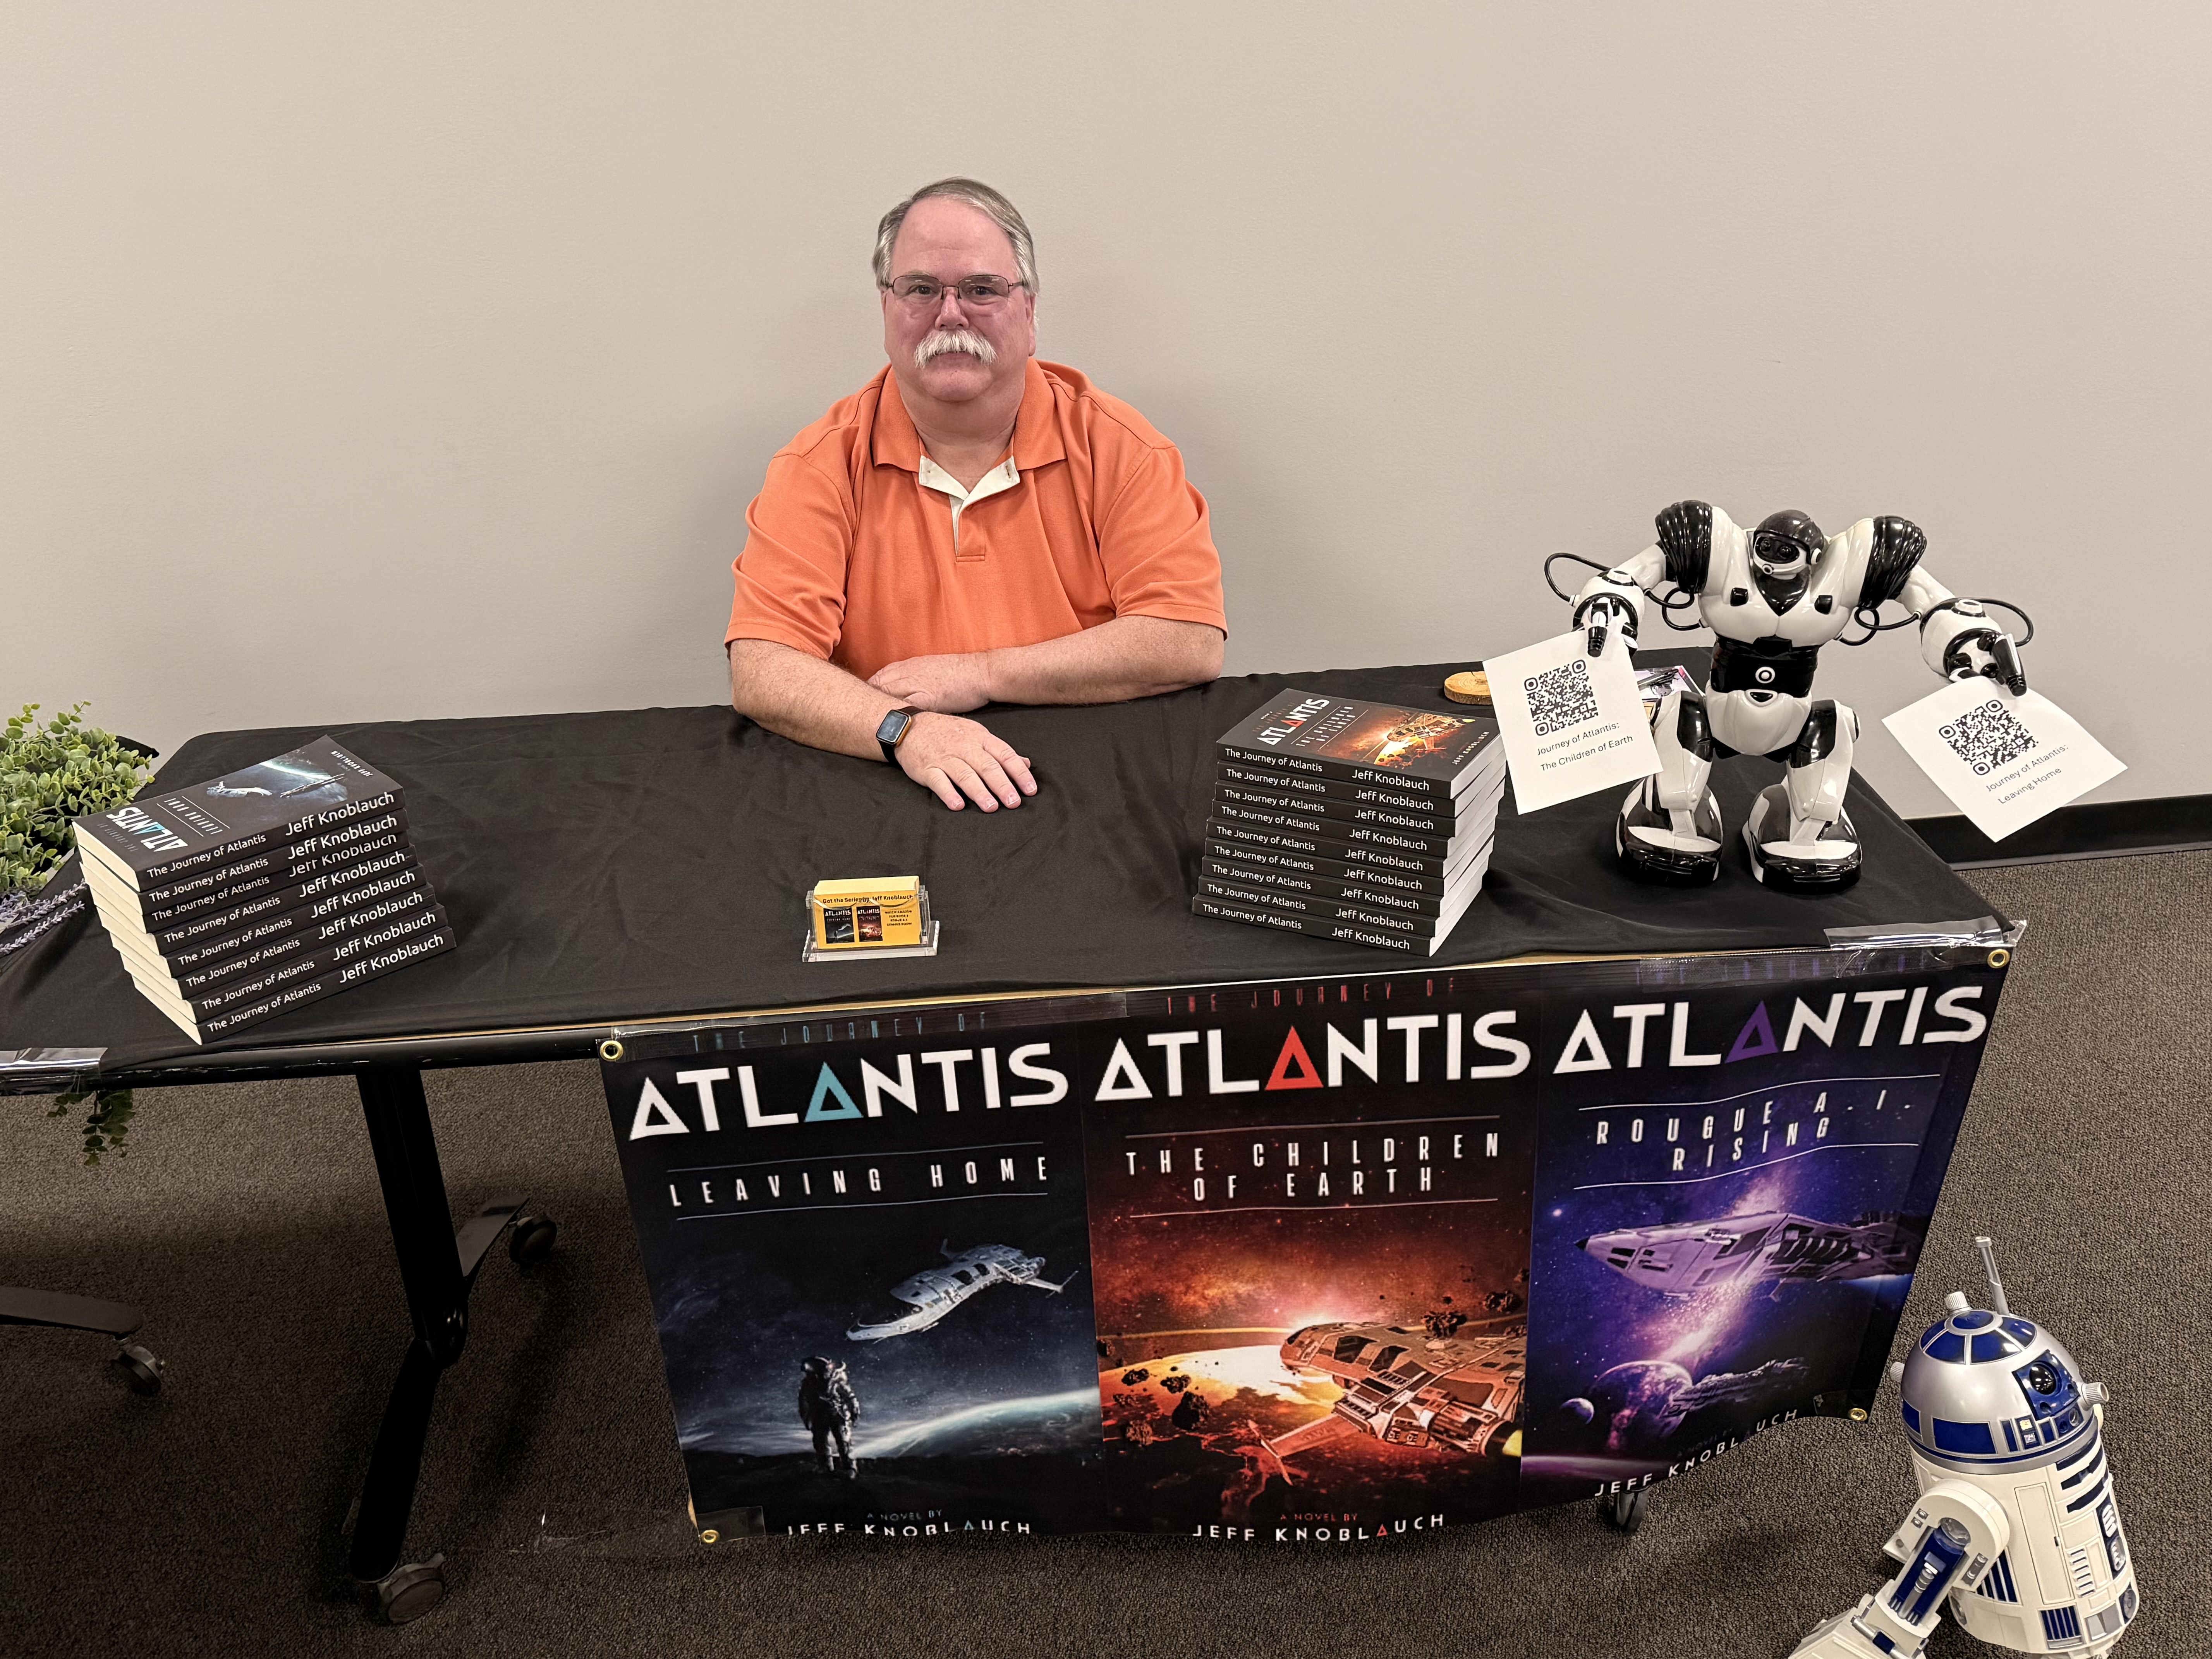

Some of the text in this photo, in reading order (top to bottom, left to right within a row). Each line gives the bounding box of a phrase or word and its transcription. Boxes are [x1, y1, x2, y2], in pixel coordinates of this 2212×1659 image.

[1256, 698, 1330, 746] ATLANTIS
[1538, 722, 1620, 755] Journey of Atlantis:
[1225, 748, 1322, 772] The Journey of Atlantis
[1540, 735, 1633, 771] The Children of Earth
[1986, 745, 2069, 792] Journey of Atlantis:
[1226, 768, 1325, 792] The Journey of Atlantis
[1352, 769, 1429, 791] Jeff Knoblauch
[1998, 768, 2061, 804] Leaving Home
[285, 791, 394, 836] Jeff Knoblauch
[1221, 806, 1320, 831] The Journey of Atlantis
[1224, 789, 1325, 812] The Journey of Atlantis
[1355, 790, 1434, 811] Jeff Knoblauch
[106, 807, 189, 852] ATLANTIS
[288, 814, 397, 859] Jeff Knoblauch
[1355, 809, 1434, 830] Jeff Knoblauch
[146, 835, 266, 878] The Journey of Atlantis
[289, 835, 397, 877] Jeff Knoblauch
[1216, 826, 1315, 851] The Journey of Atlantis
[1349, 829, 1427, 850] Jeff Knoblauch
[299, 851, 405, 897] Jeff Knoblauch
[1214, 845, 1314, 871] The Journey of Atlantis
[1345, 849, 1423, 871] Jeff Knoblauch
[149, 858, 268, 902] The Journey of Atlantis
[311, 871, 415, 918] Jeff Knoblauch
[1212, 864, 1311, 890] The Journey of Atlantis
[1344, 869, 1422, 890] Jeff Knoblauch
[151, 877, 270, 921] The Journey of Atlantis
[319, 891, 423, 939] Jeff Knoblauch
[1207, 884, 1306, 910] The Journey of Atlantis
[1341, 888, 1419, 910] Jeff Knoblauch
[164, 897, 280, 943] The Journey of Atlantis
[1202, 903, 1302, 929] The Journey of Atlantis
[1335, 908, 1413, 931] Jeff Knoblauch
[177, 918, 292, 965] The Journey of Atlantis
[333, 912, 436, 961] Jeff Knoblauch
[1331, 927, 1410, 950] Jeff Knoblauch
[185, 939, 300, 987] The Journey of Atlantis
[340, 934, 443, 983] Jeff Knoblauch
[201, 961, 315, 1009] The Journey of Atlantis
[1251, 982, 1391, 1008] JOURNEY
[207, 983, 321, 1032] The Journey of Atlantis
[781, 1017, 922, 1045] JOURNEY
[1553, 986, 1987, 1074] ATLANTIS
[1094, 1010, 1531, 1101] ATLANTIS
[629, 1042, 1068, 1141] ATLANTIS
[1597, 1101, 1773, 1145] ROUGUE
[1126, 1133, 1498, 1175] THE CHILDREN
[1673, 1117, 1829, 1171] RISING
[670, 1157, 1047, 1207] LEAVING HOME
[1194, 1167, 1431, 1201] OF EARTH
[1594, 1473, 1653, 1497] JEFF
[864, 1519, 1030, 1537] KNOBLAUCH
[881, 1511, 922, 1522] NOVEL
[929, 1510, 942, 1518] BY
[1193, 1514, 1443, 1541] JEFF KNOBLAUCH
[1295, 1513, 1336, 1522] NOVEL
[1343, 1513, 1358, 1522] BY
